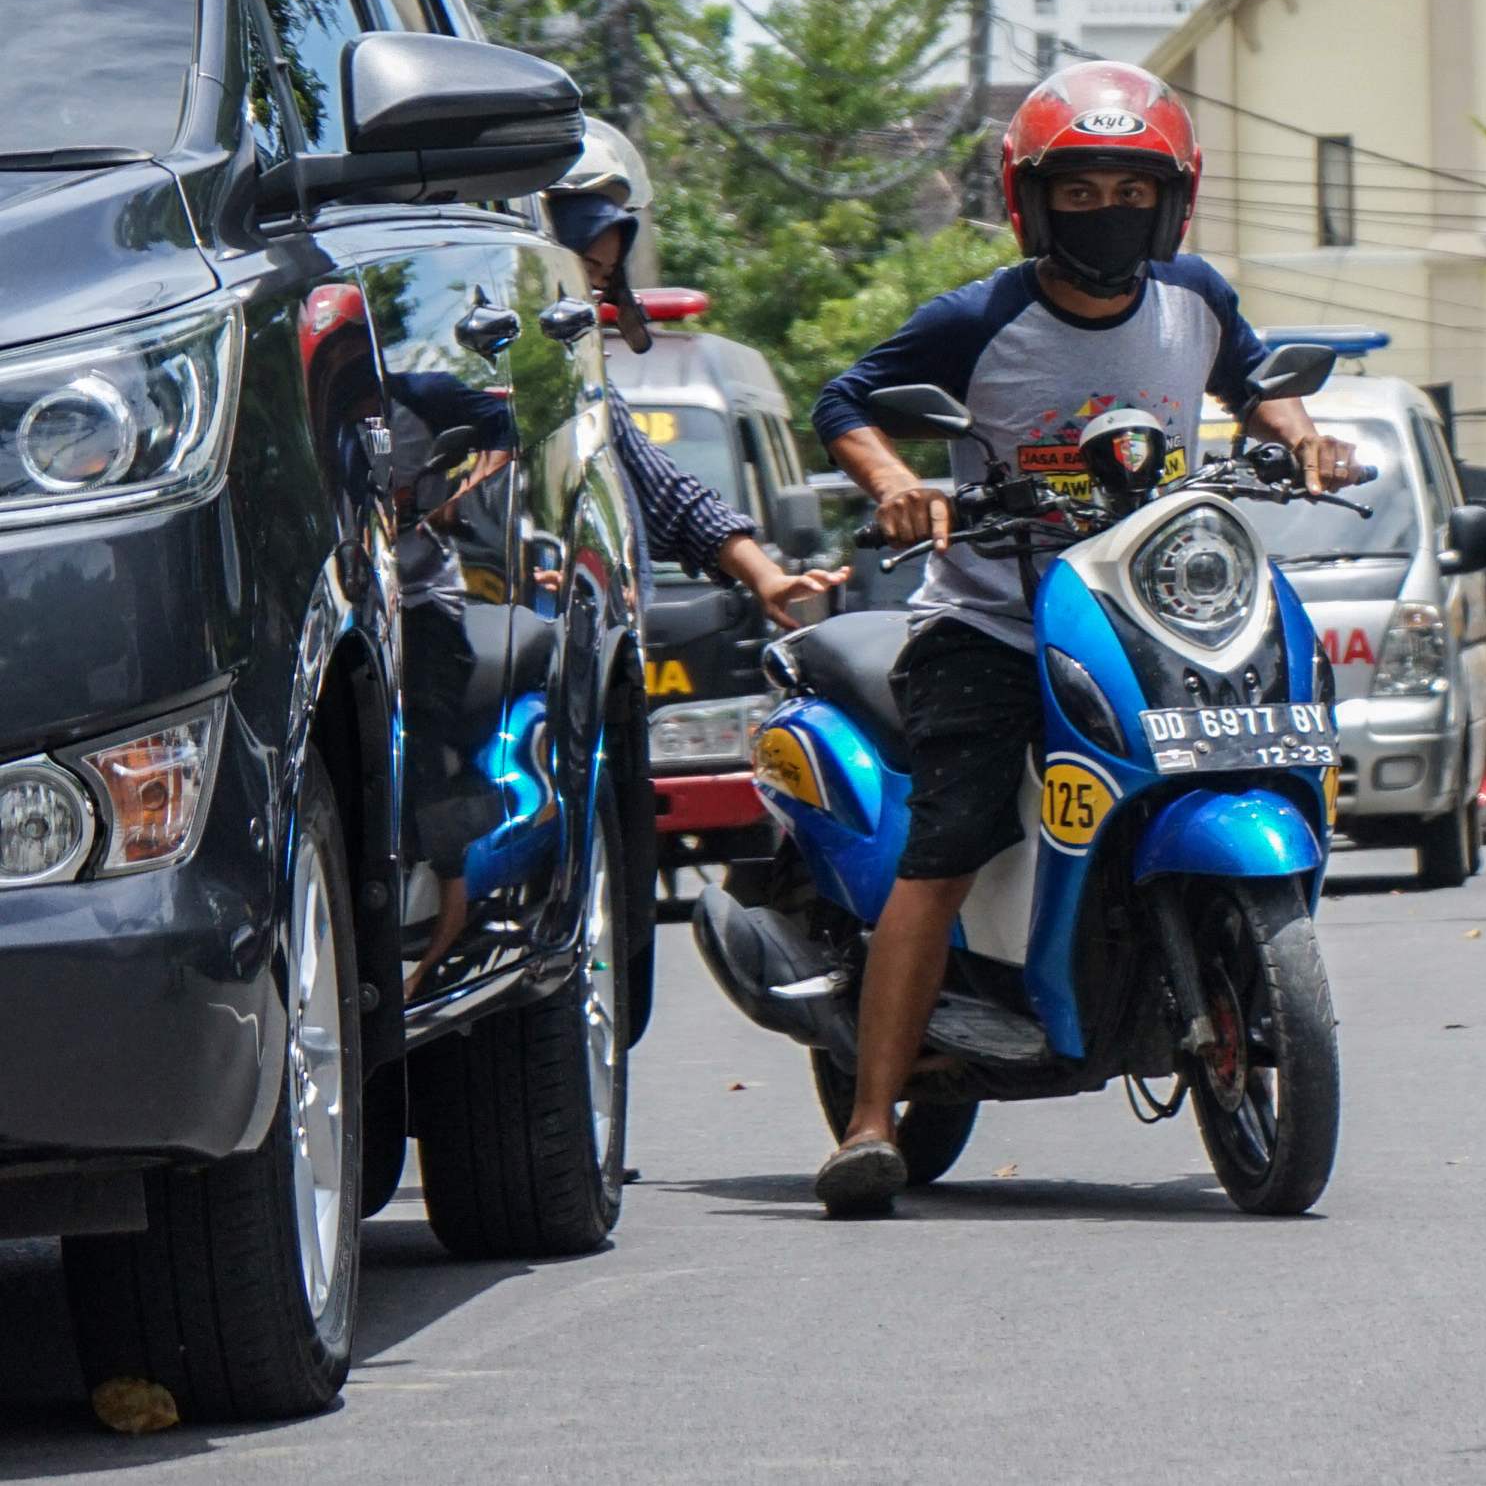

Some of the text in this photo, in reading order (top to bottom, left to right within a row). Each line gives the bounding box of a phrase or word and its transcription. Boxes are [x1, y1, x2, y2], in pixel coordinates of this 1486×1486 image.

[1021, 451, 1083, 465] JASA RA
[1146, 711, 1186, 741] DD
[1199, 707, 1276, 737] 6977
[1047, 779, 1095, 828] 125
